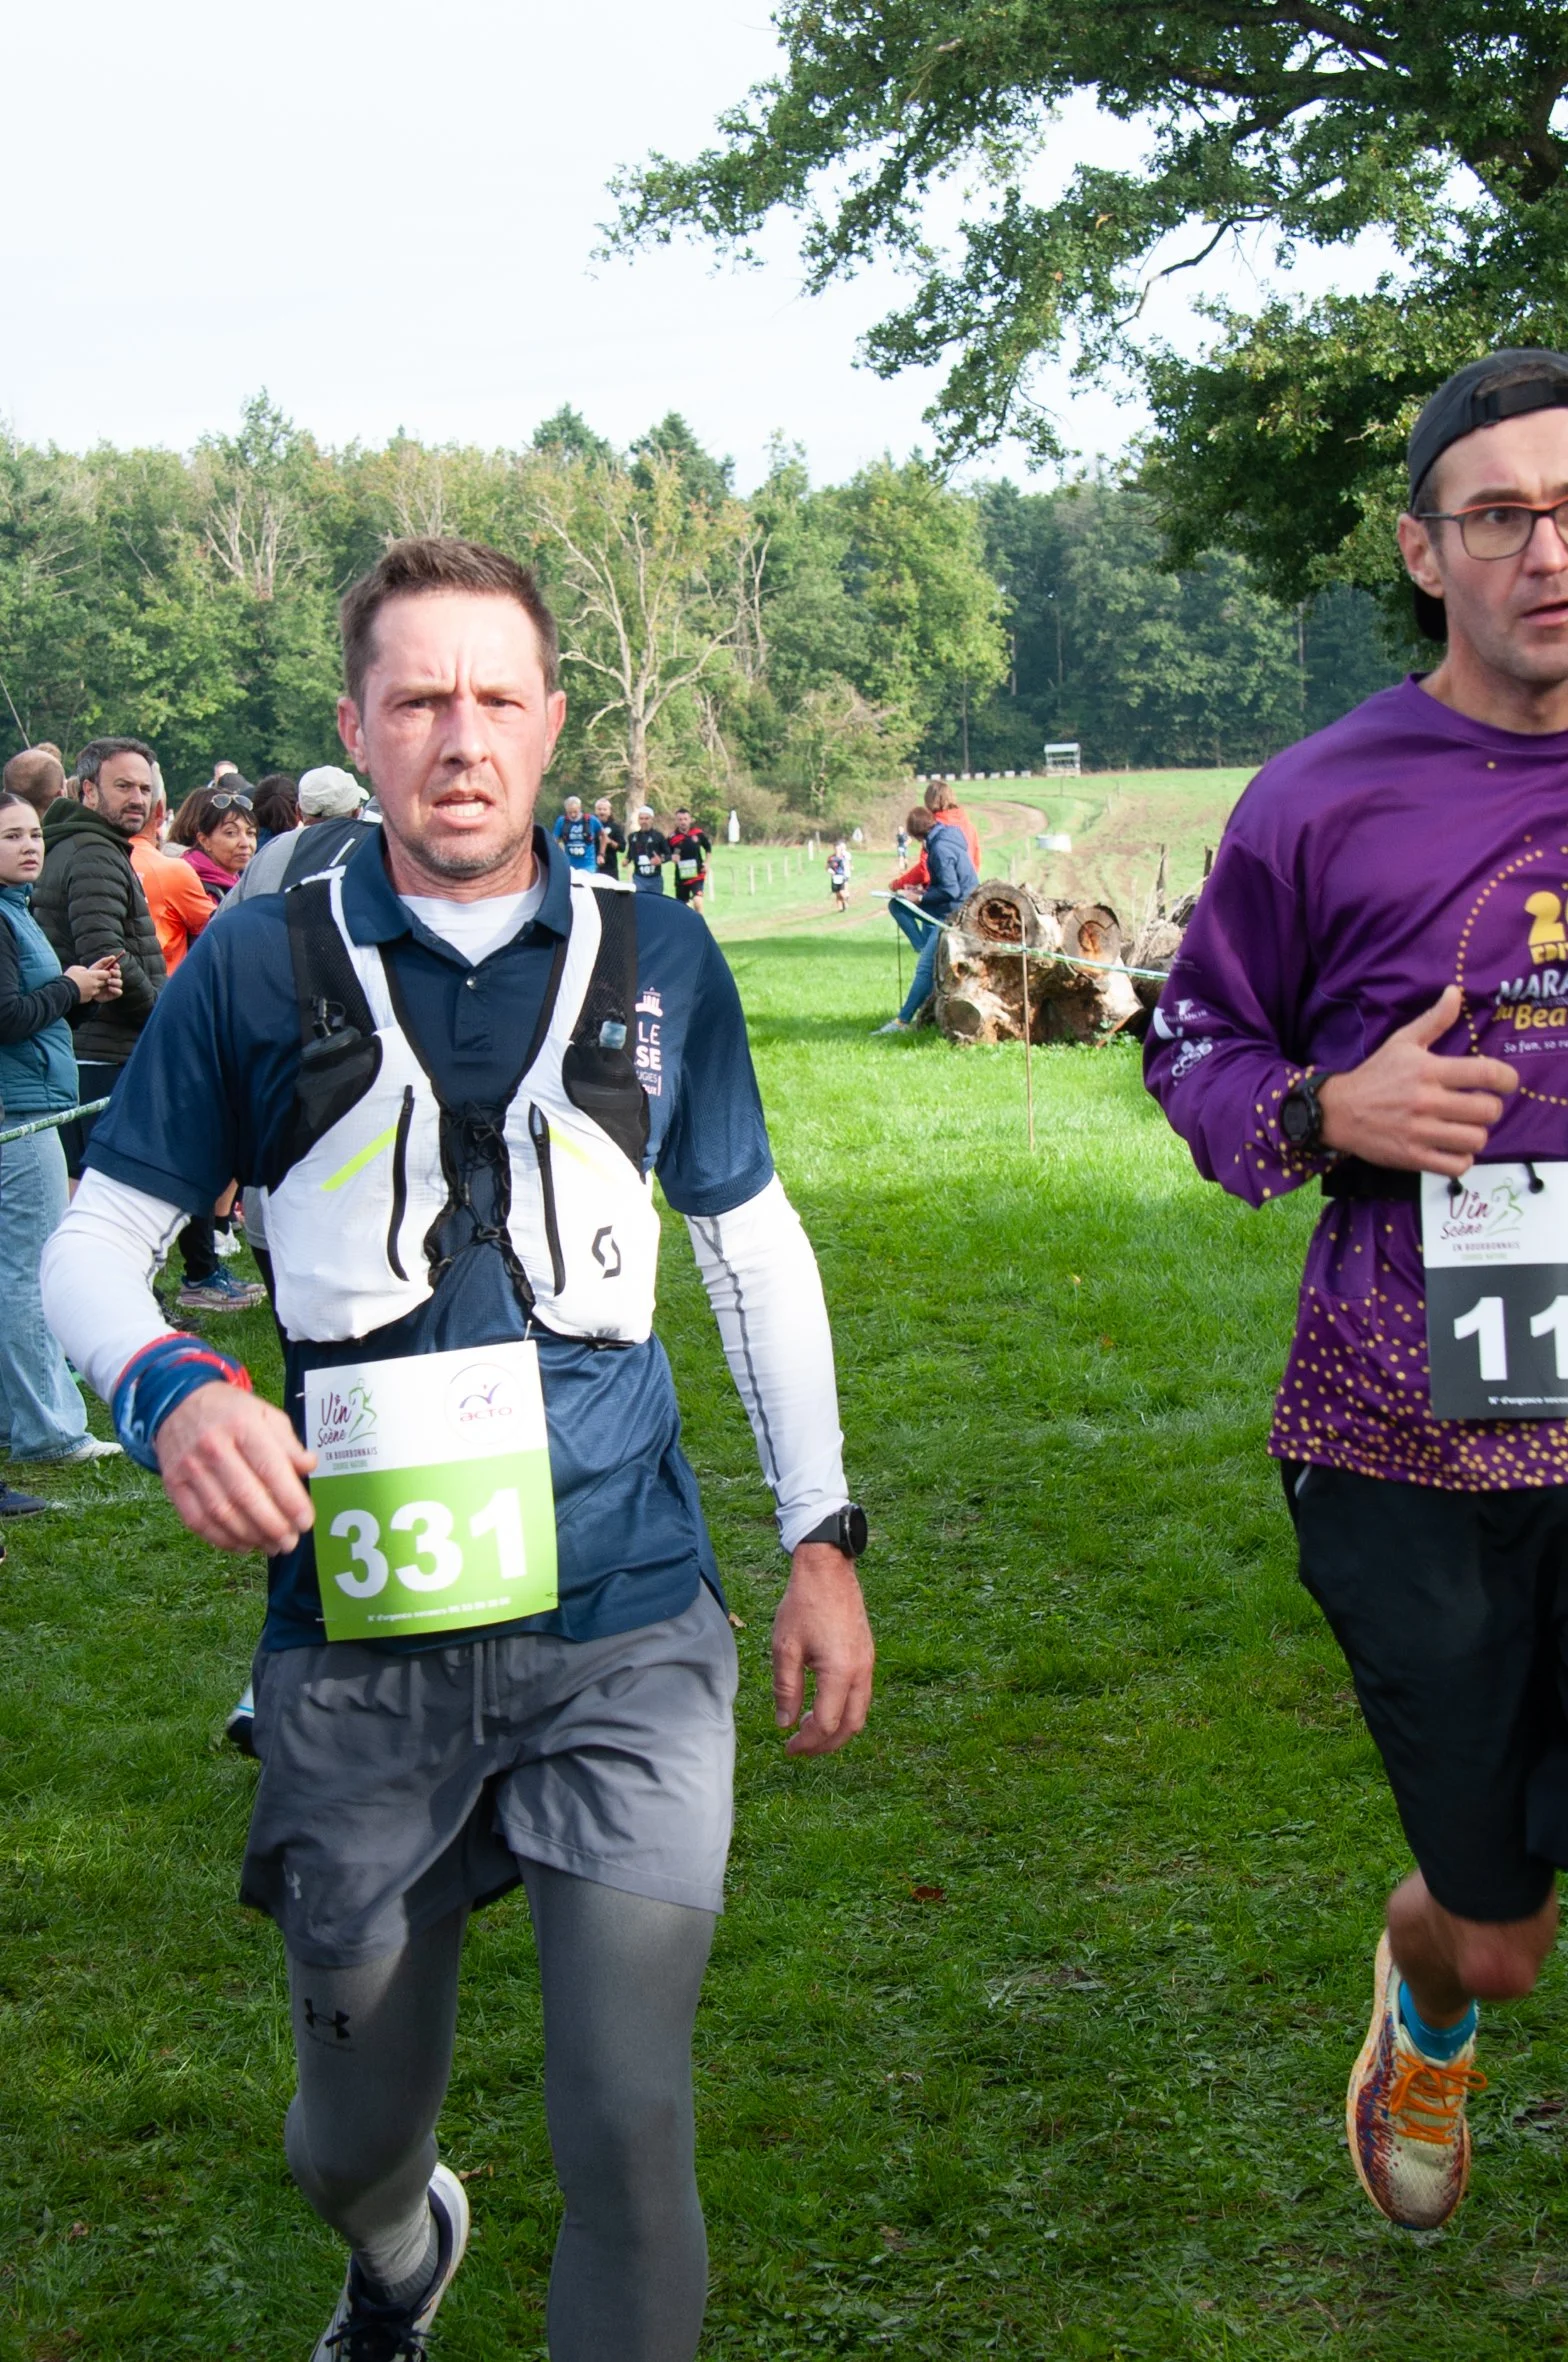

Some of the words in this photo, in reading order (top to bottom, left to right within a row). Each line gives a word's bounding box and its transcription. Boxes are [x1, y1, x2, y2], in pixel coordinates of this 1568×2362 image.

[1525, 891, 1568, 945] 2
[635, 1045, 662, 1071] SE
[1450, 1189, 1490, 1219] Vin
[321, 1392, 352, 1426] Vin
[317, 1427, 346, 1448] Scène
[329, 1487, 528, 1599] 331
